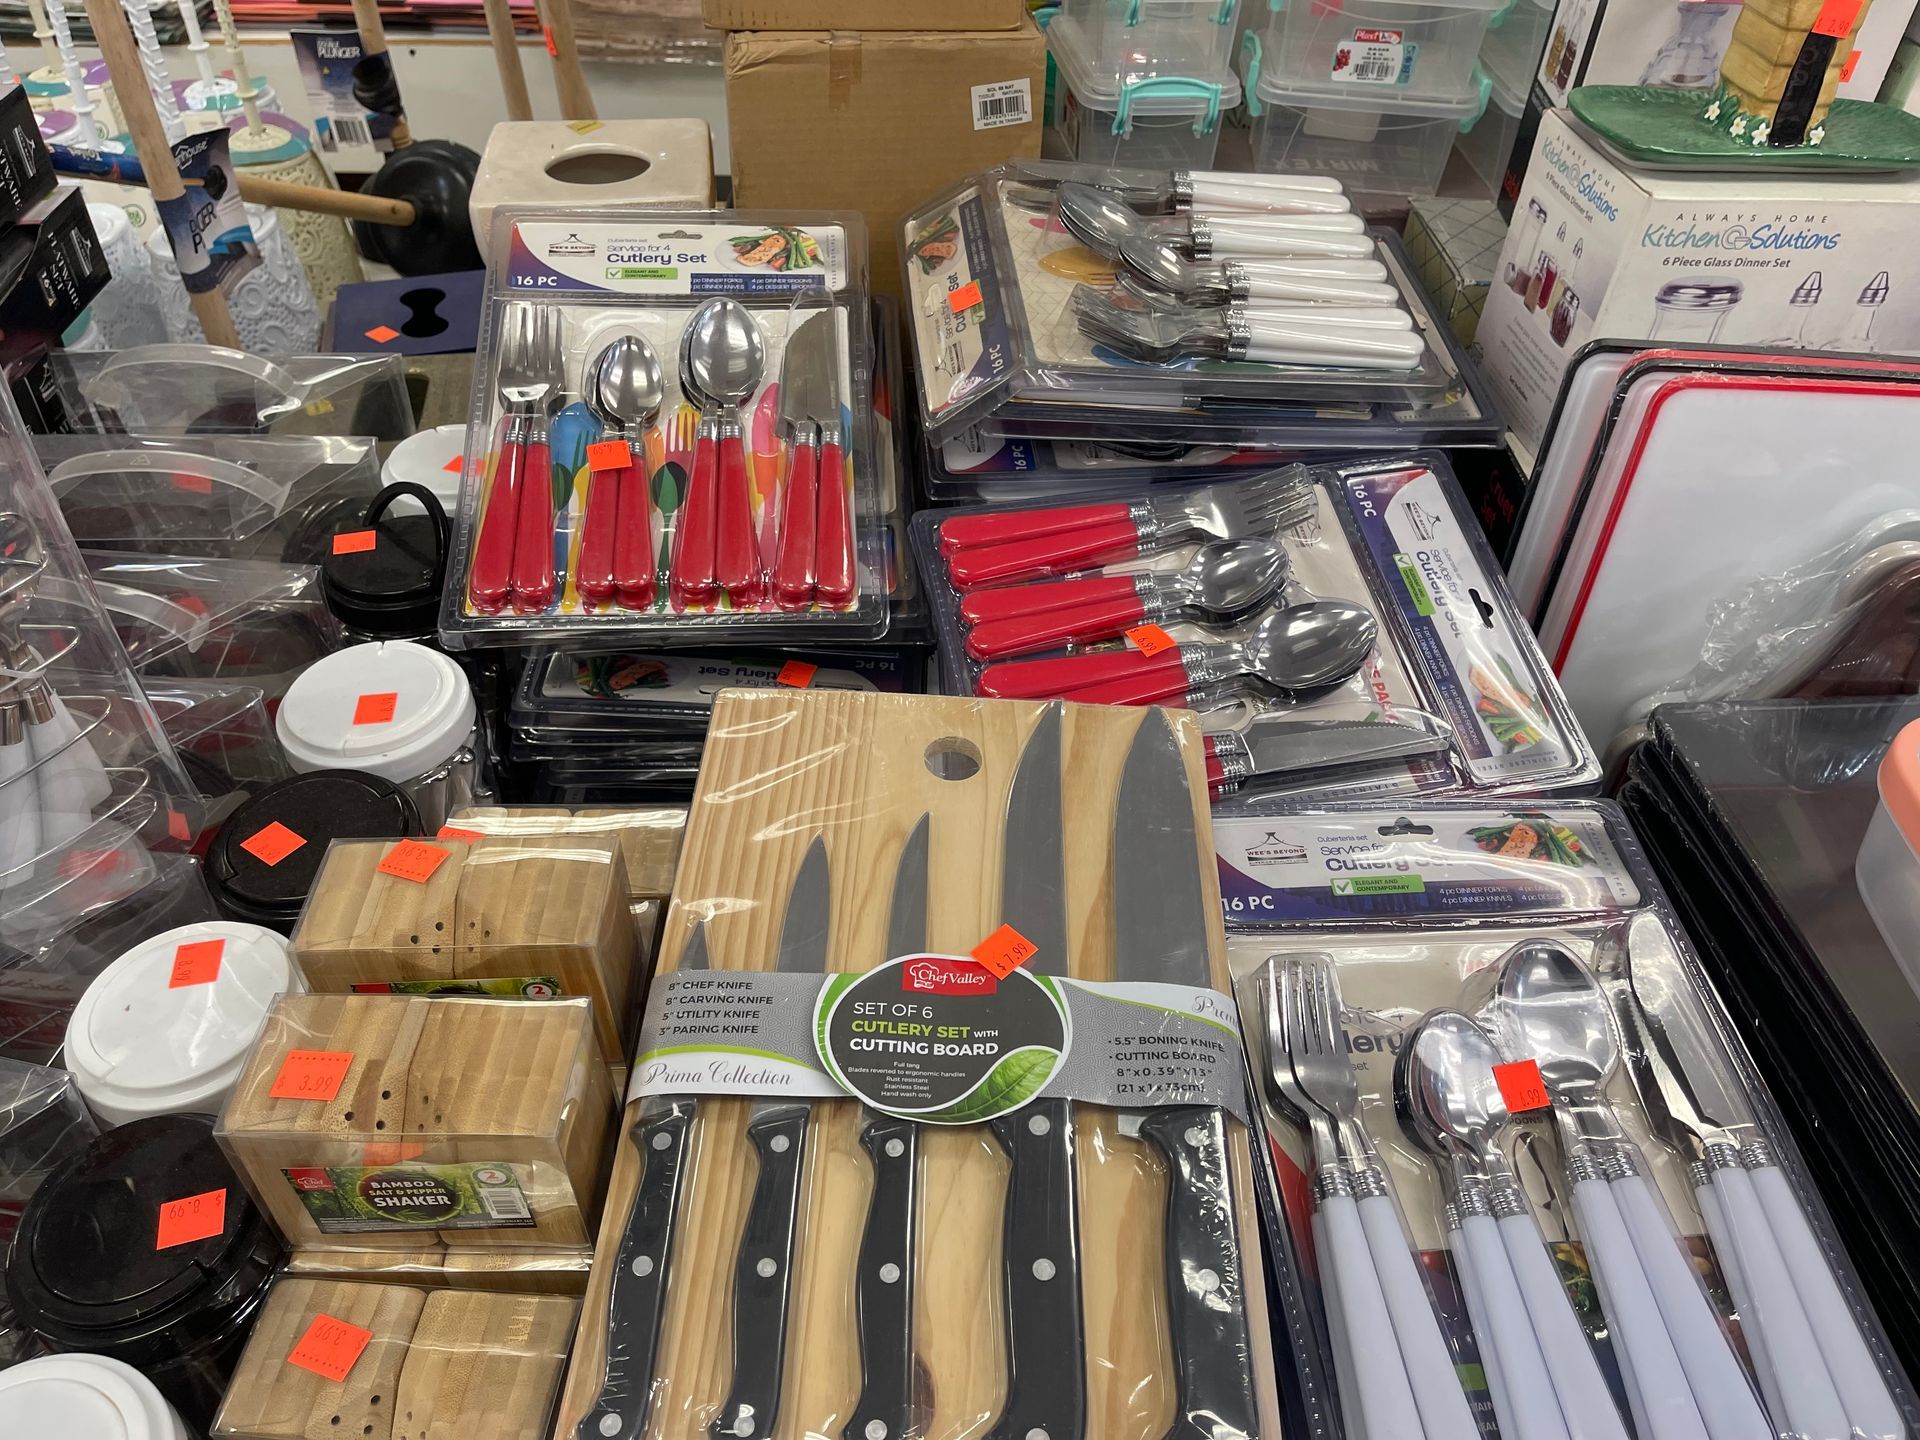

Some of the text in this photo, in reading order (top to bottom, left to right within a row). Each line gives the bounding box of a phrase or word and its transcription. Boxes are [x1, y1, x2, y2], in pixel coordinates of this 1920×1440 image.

[1578, 173, 1619, 222] Solutions
[1676, 213, 1829, 224] ALWAYS HOME
[1641, 223, 1841, 250] Kitchen Solutions
[607, 244, 671, 252] Service for 4
[607, 253, 672, 265] Cutlery
[677, 252, 707, 264] Set
[1662, 257, 1791, 269] 6 Piece Glass Dinner Set
[47, 231, 82, 311] FLATWARE
[50, 264, 65, 292] SET
[516, 275, 557, 286] 16 PC
[947, 272, 960, 292] Set
[989, 343, 1004, 374] 16 PC
[1012, 444, 1027, 471] 16 PC
[1353, 484, 1377, 518] 16 PC
[1430, 548, 1452, 583] Service
[1416, 550, 1448, 607] Cutlery
[855, 660, 896, 671] 16 PC
[698, 666, 778, 681] tlery Set
[1357, 834, 1368, 842] set
[1273, 848, 1305, 856] BEYOND
[1320, 845, 1370, 856] Service
[1355, 879, 1382, 887] ELEGANT
[1356, 884, 1410, 892] CONTEMPORARY
[1223, 895, 1275, 912] 16 PC
[1458, 896, 1486, 904] DINNER
[1004, 942, 1028, 967] 7.99
[918, 969, 987, 988] Chef Valley
[668, 981, 753, 992] 8" CHEF KNIFE
[665, 995, 774, 1006] 8" CARVING KNIFE
[662, 1010, 760, 1021] 5" UTILITY KNIFE
[853, 1002, 933, 1019] SET OF 6
[659, 1025, 759, 1036] 3" PARING KNIFE
[851, 1020, 999, 1039] CUTLERY SET WITH
[850, 1038, 999, 1056] CUTTING BOARD
[1115, 1036, 1226, 1053] 5.5" BONING KNIFE
[1343, 1030, 1403, 1056] lery
[1115, 1051, 1216, 1064] CUTTING BOARD
[641, 1060, 794, 1087] Prima Collection
[905, 1070, 940, 1078] ergonomic
[299, 1075, 334, 1092] 3.99
[1117, 1083, 1134, 1094] (21
[1138, 1085, 1146, 1093] x
[483, 1171, 498, 1180] 2
[370, 1180, 435, 1190] BAMBOO
[369, 1187, 447, 1197] SALT & PEPPER
[374, 1195, 452, 1208] SHAKER
[170, 1198, 201, 1220] 8.99
